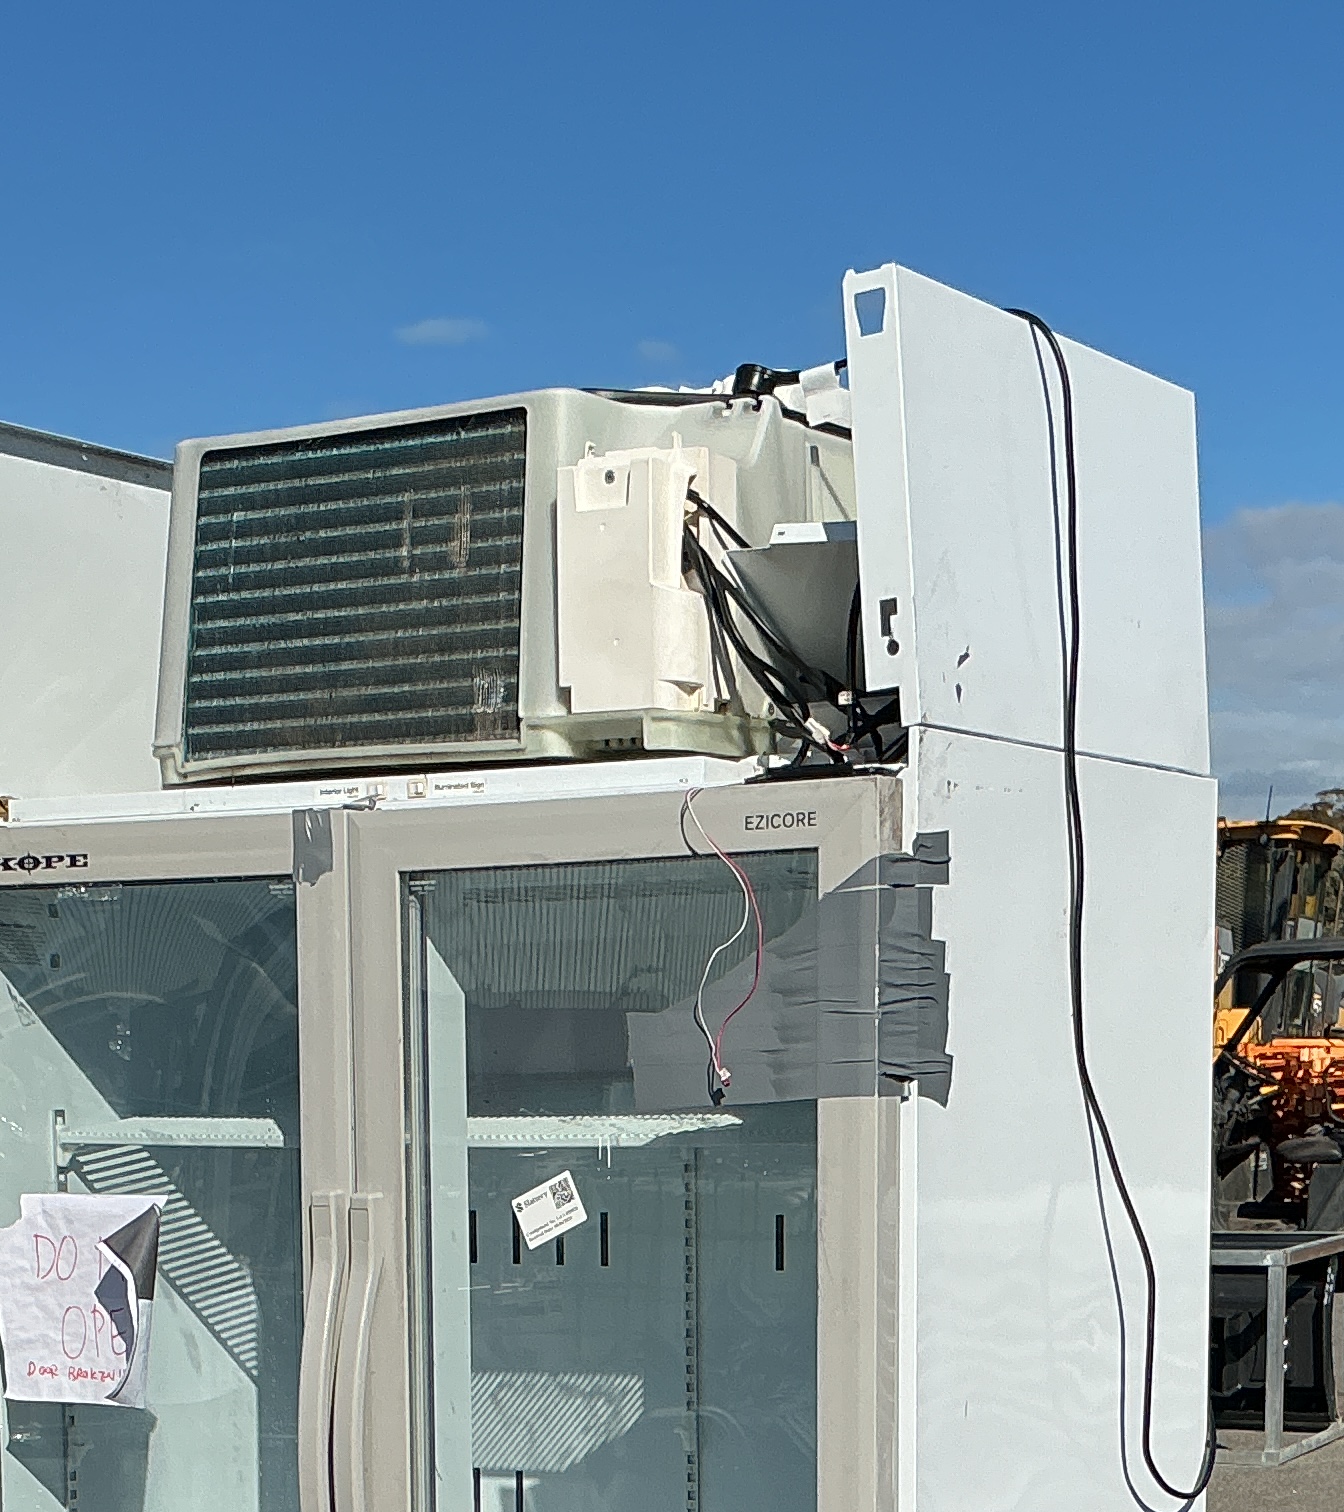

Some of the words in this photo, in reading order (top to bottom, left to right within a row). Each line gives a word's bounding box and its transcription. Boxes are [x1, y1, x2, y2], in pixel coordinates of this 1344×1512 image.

[744, 811, 818, 831] EZICORE
[33, 1234, 78, 1281] DO
[62, 1304, 127, 1360] OPE
